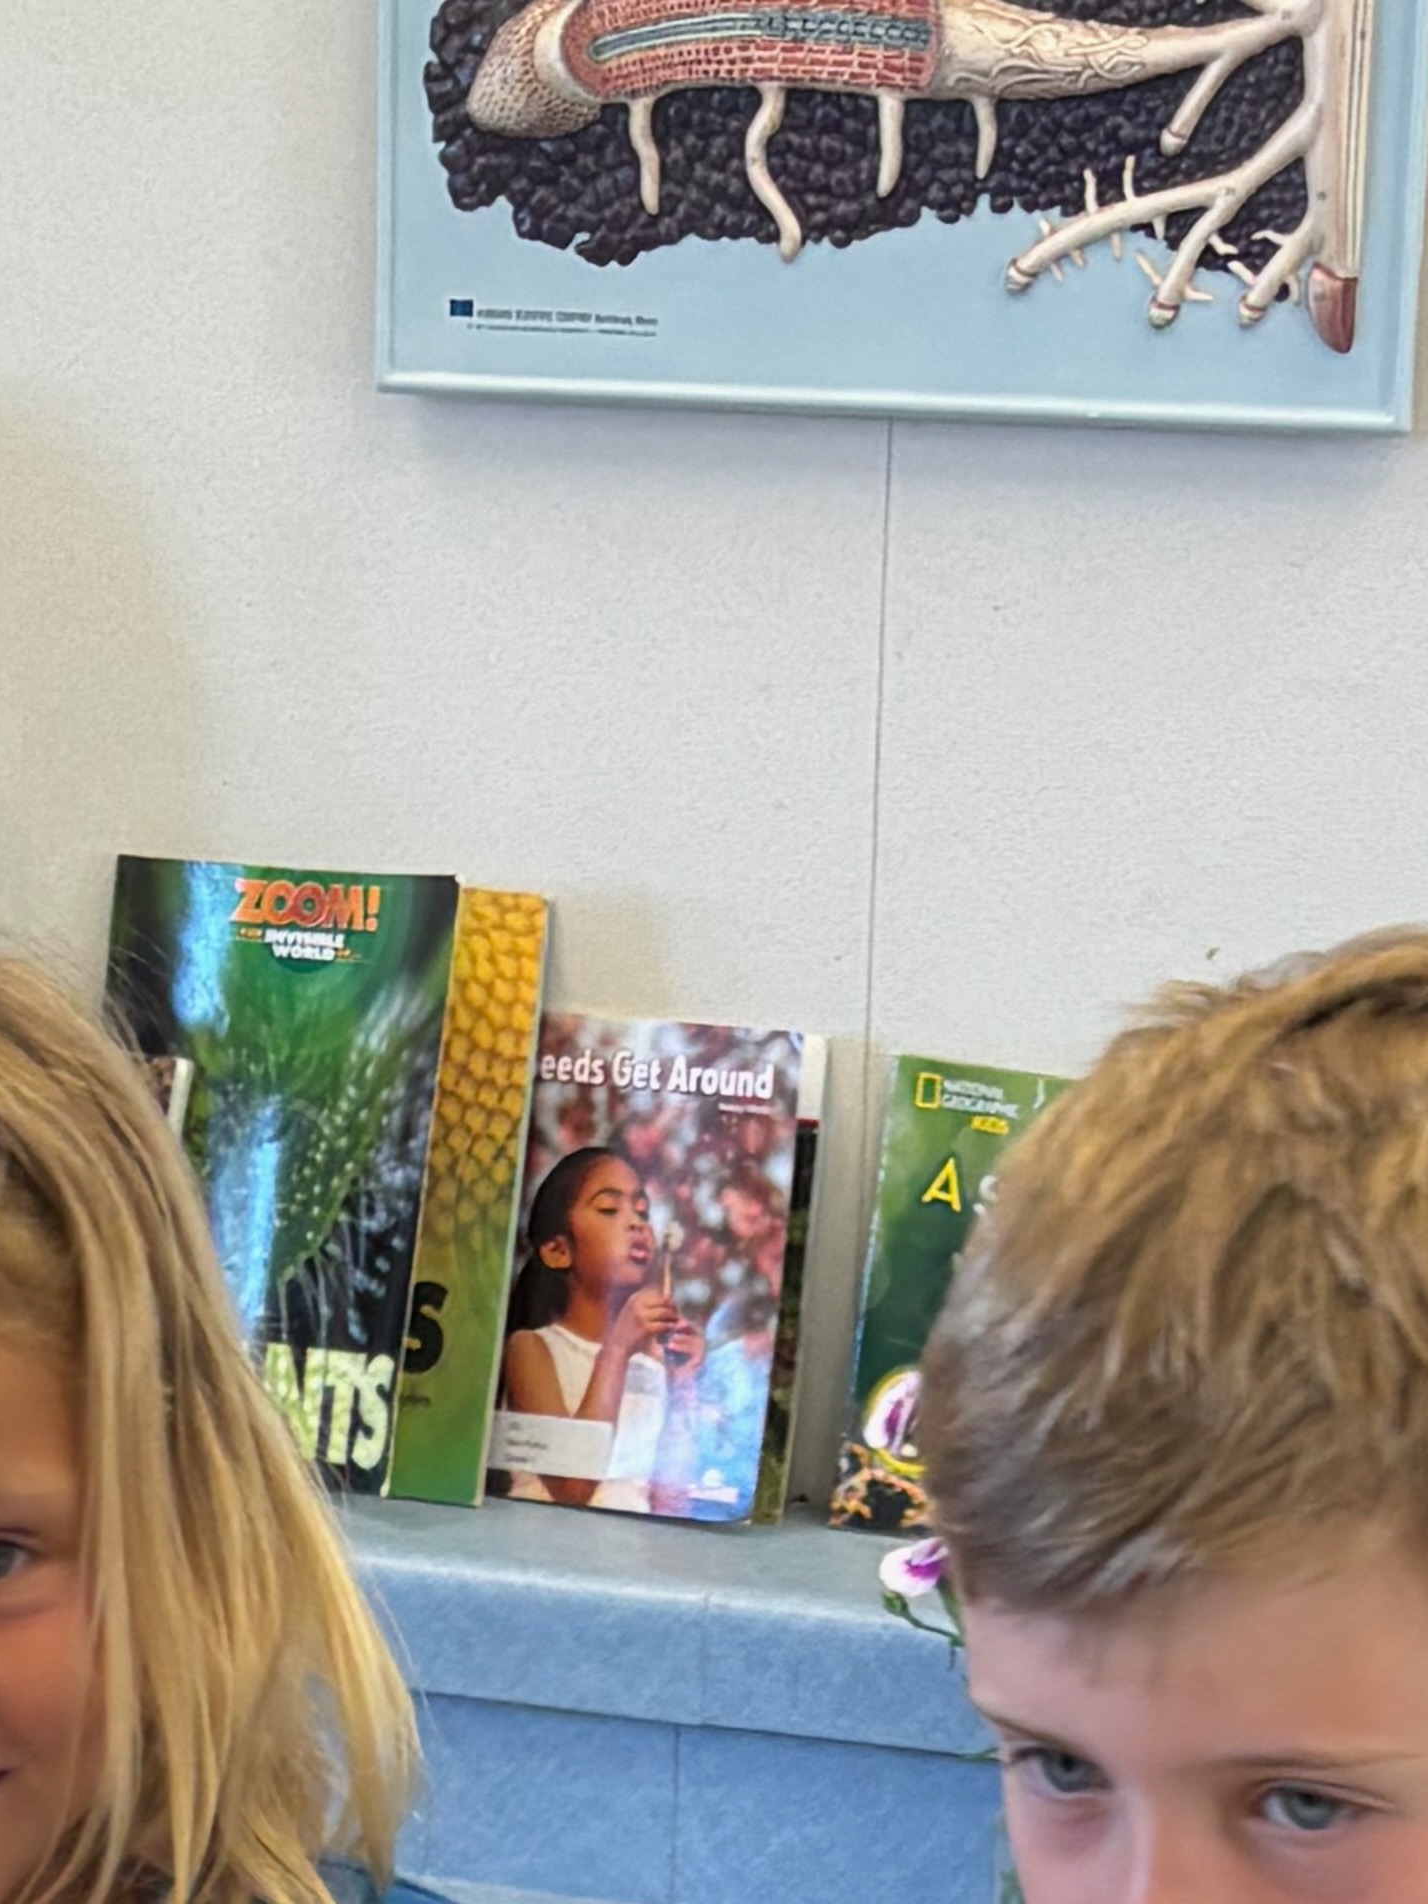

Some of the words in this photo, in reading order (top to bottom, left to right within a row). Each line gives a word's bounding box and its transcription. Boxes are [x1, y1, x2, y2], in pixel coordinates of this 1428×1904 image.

[231, 881, 381, 932] ZOOM!
[272, 944, 336, 962] WORLD
[539, 1052, 605, 1087] eeds
[611, 1049, 663, 1092] Get
[667, 1054, 774, 1100] Around
[265, 1342, 395, 1471] NTS
